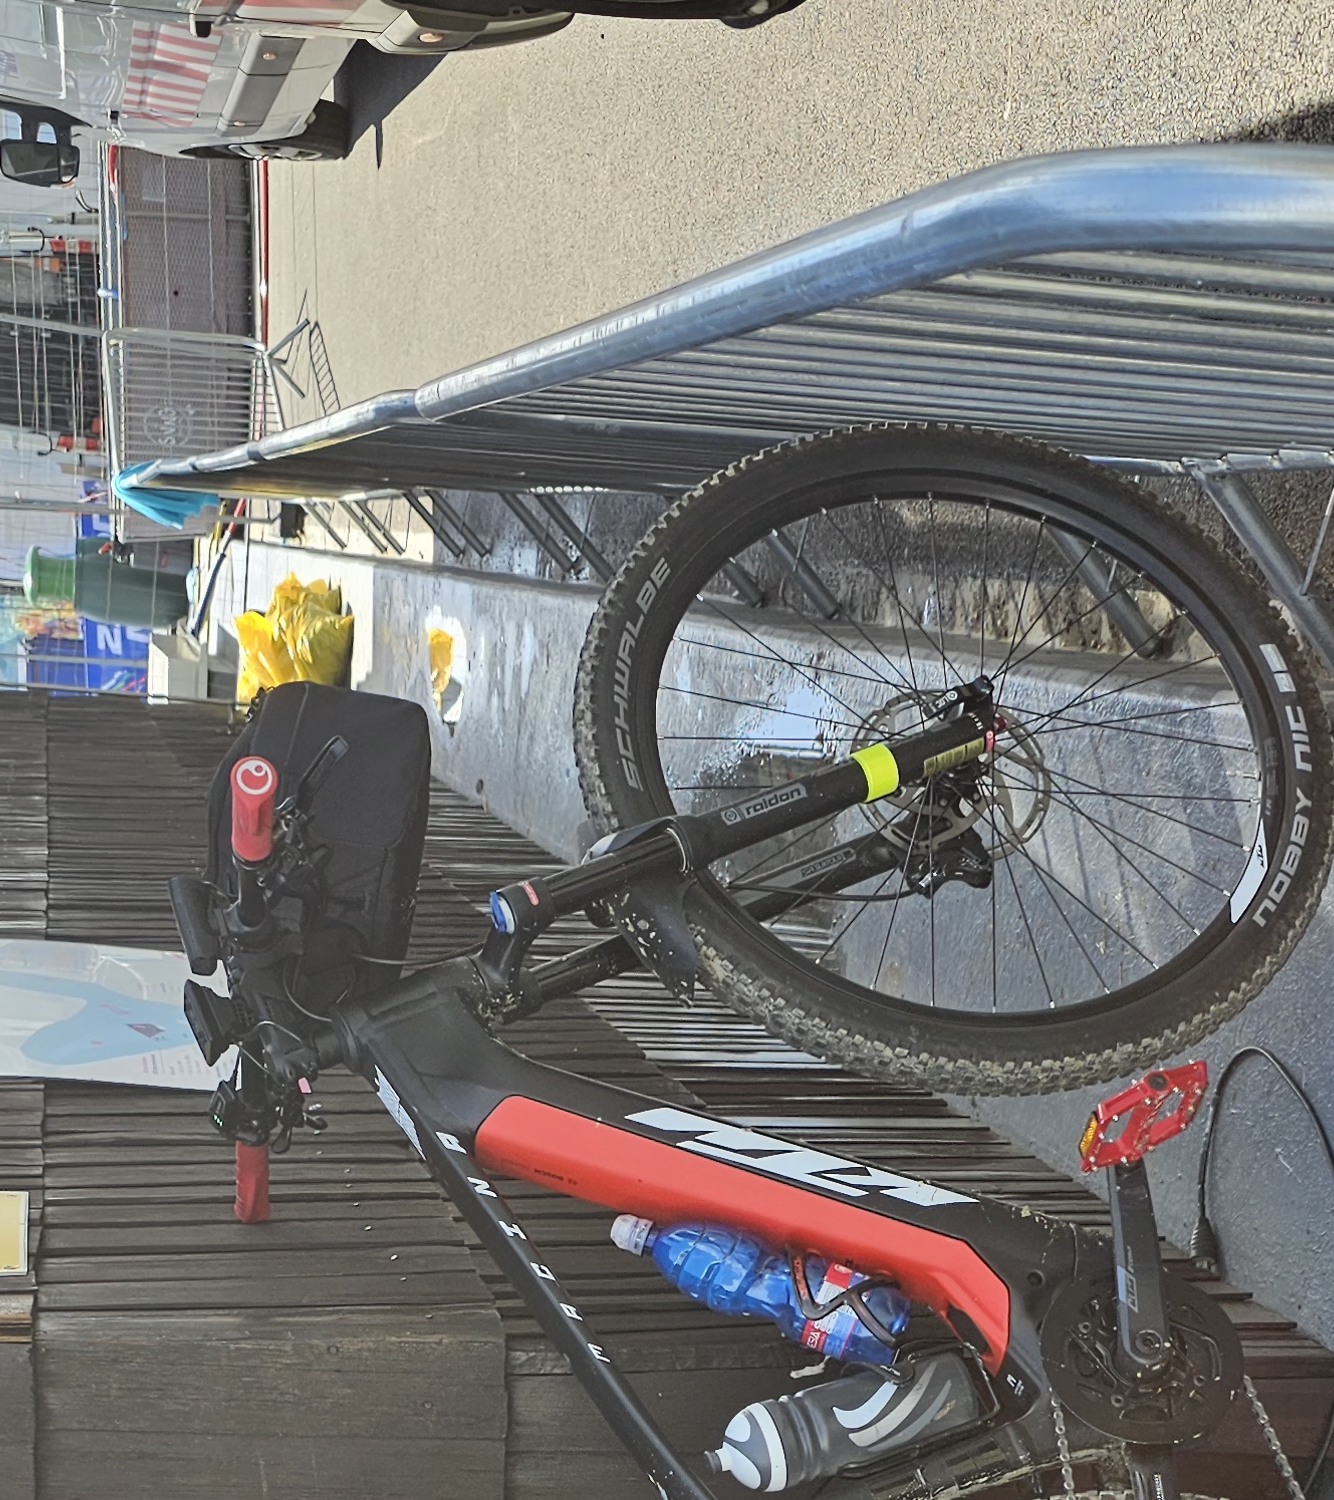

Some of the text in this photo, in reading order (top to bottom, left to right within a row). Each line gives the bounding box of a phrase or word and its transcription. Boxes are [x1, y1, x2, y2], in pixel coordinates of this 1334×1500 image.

[613, 556, 671, 792] SCHWALBE
[744, 787, 802, 817] raidon
[1251, 704, 1313, 928] NOBBY NIC
[435, 1131, 611, 1363] MACINA
